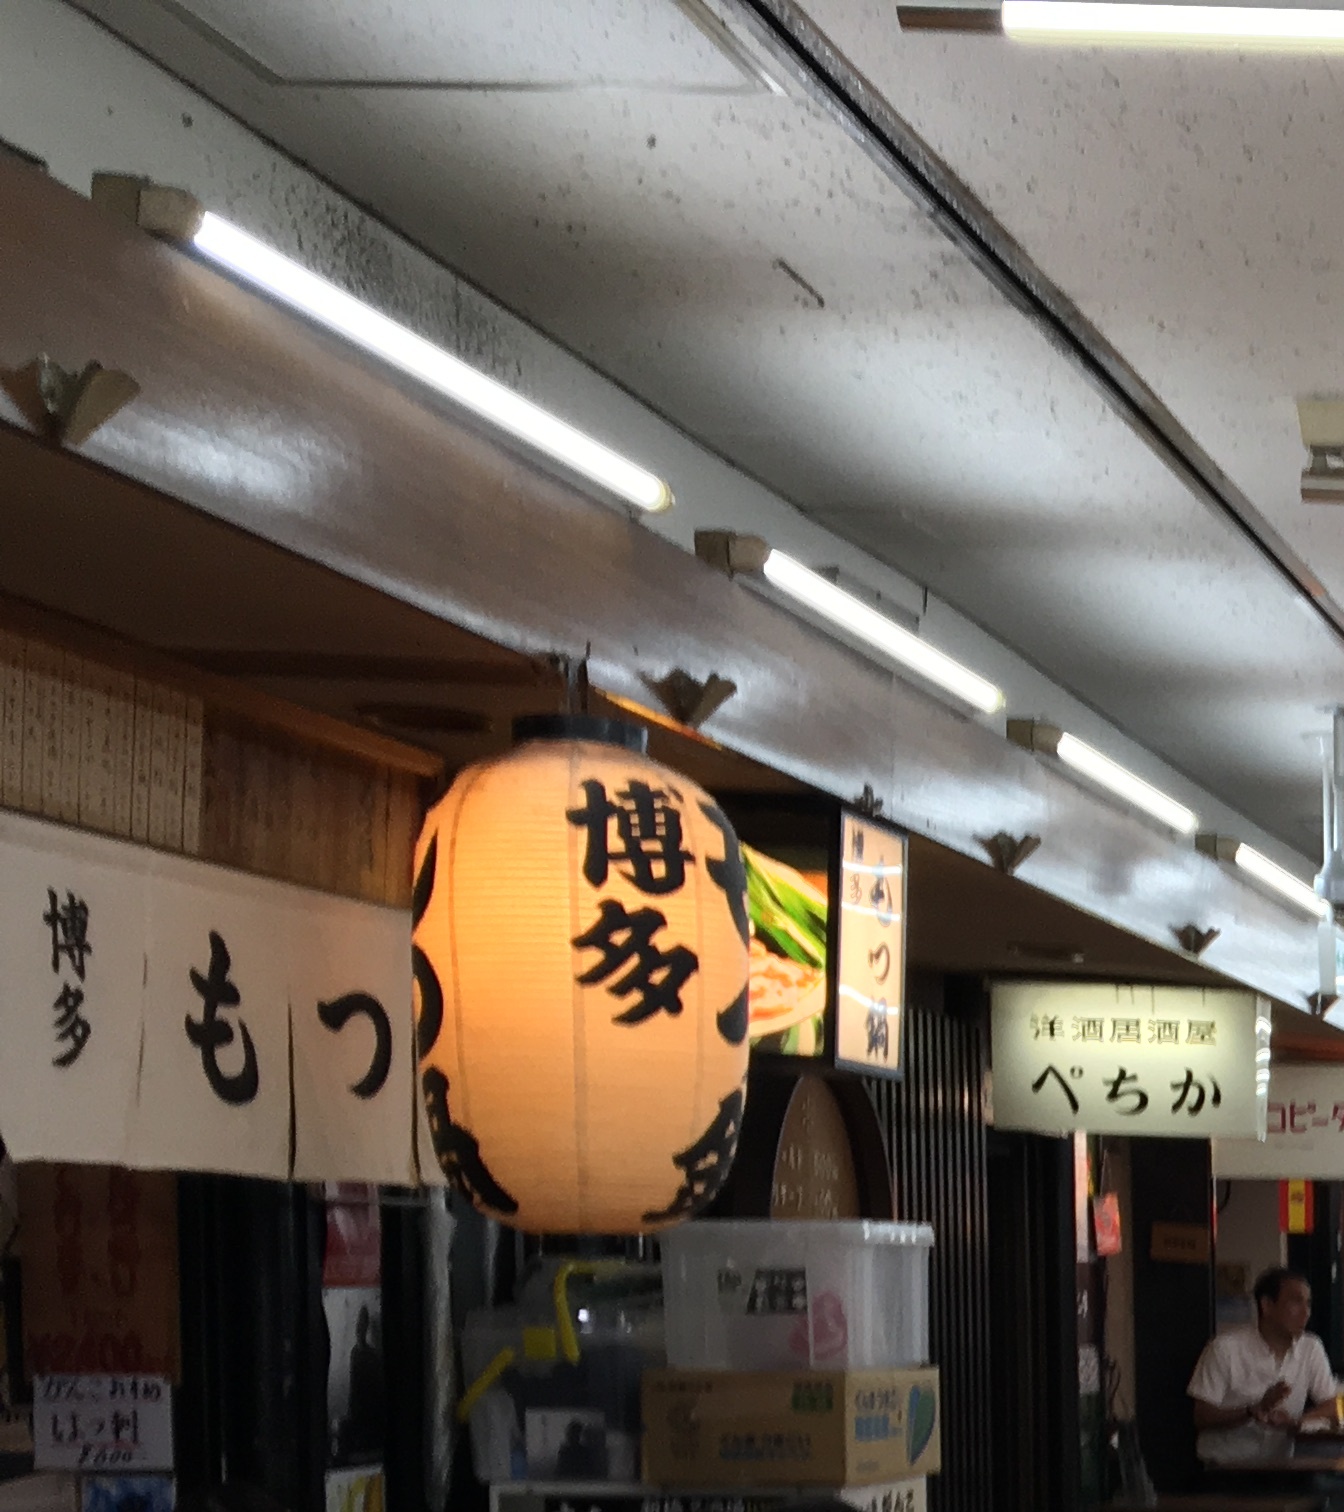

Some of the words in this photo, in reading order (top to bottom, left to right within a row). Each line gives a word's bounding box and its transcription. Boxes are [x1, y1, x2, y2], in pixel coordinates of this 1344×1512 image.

[43, 885, 93, 1069] 博多
[565, 777, 701, 1027] 博多
[184, 929, 393, 1107] もつ
[1029, 1012, 1218, 1047] 洋酒居酒屋
[1031, 1062, 1222, 1118] ぺちか
